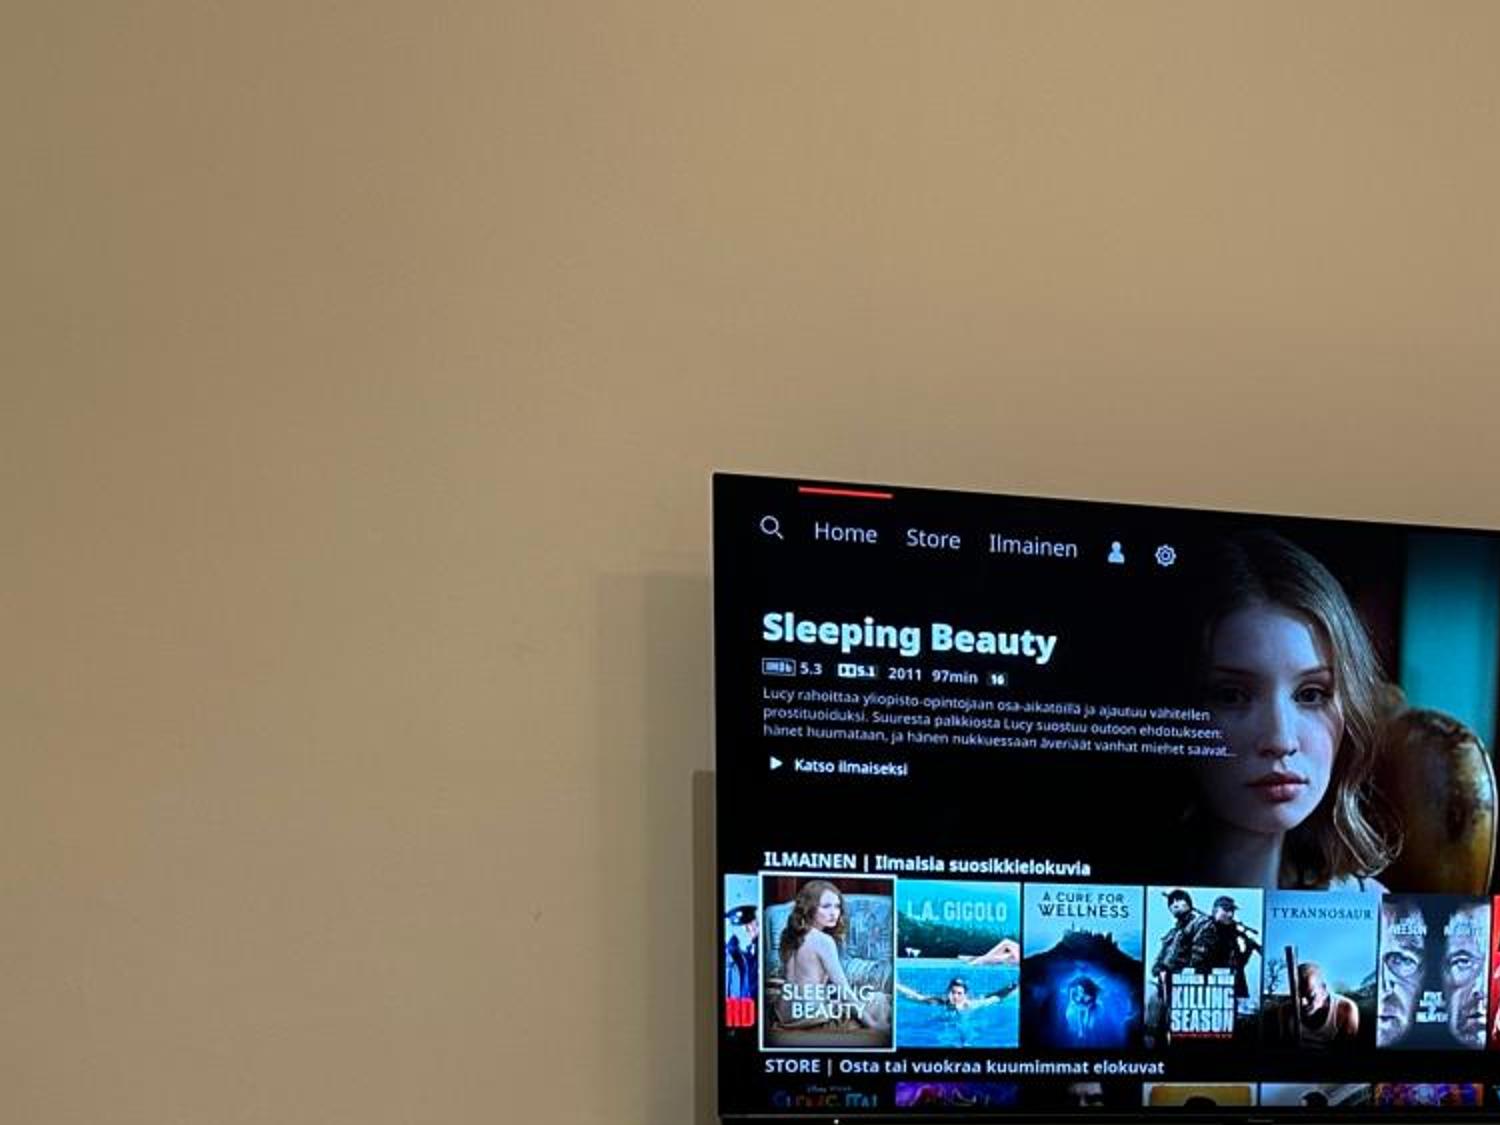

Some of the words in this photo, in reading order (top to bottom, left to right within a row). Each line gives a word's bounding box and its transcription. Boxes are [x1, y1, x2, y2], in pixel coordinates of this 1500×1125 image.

[815, 521, 878, 543] Home
[906, 528, 961, 549] Store
[989, 533, 1078, 558] Ilmainen
[762, 611, 921, 657] Sleeping
[931, 622, 1057, 664] Beauty
[800, 661, 823, 676] 5.3
[887, 667, 922, 681] 2011
[931, 669, 979, 684] 97min
[763, 687, 794, 702] Lucy
[798, 689, 859, 704] rahoittaa
[1084, 706, 1096, 719] ja
[872, 711, 931, 726] Suuresta
[934, 713, 1001, 729] palkkiosta
[1003, 719, 1034, 734] Lucy
[1036, 721, 1088, 734] suostuu
[1090, 723, 1137, 737] outoon
[890, 730, 904, 746] ja
[952, 732, 1037, 749] nukkuessaan
[1094, 739, 1139, 754] vanhat
[1141, 742, 1185, 756] miehet
[794, 758, 835, 774] Katso
[838, 759, 909, 776] ilmaiseksi
[763, 851, 857, 870] ILMAINEN
[874, 854, 945, 873] Ilmaisia
[949, 857, 1092, 877] suosikkielokuvia
[1038, 904, 1130, 919] WELLNESS
[1271, 906, 1374, 921] TYRANNOSAUR
[782, 982, 875, 1002] SLEEPING
[1171, 985, 1235, 1009] KILLING
[791, 1001, 867, 1019] BEAUTY
[1170, 1009, 1235, 1033] SEASON
[764, 1058, 821, 1073] STORE
[839, 1058, 880, 1073] Osta
[884, 1058, 907, 1074] tai
[911, 1058, 981, 1074] vuokraa
[986, 1058, 1089, 1075] kuumimmat
[1093, 1059, 1166, 1075] elokuvat
